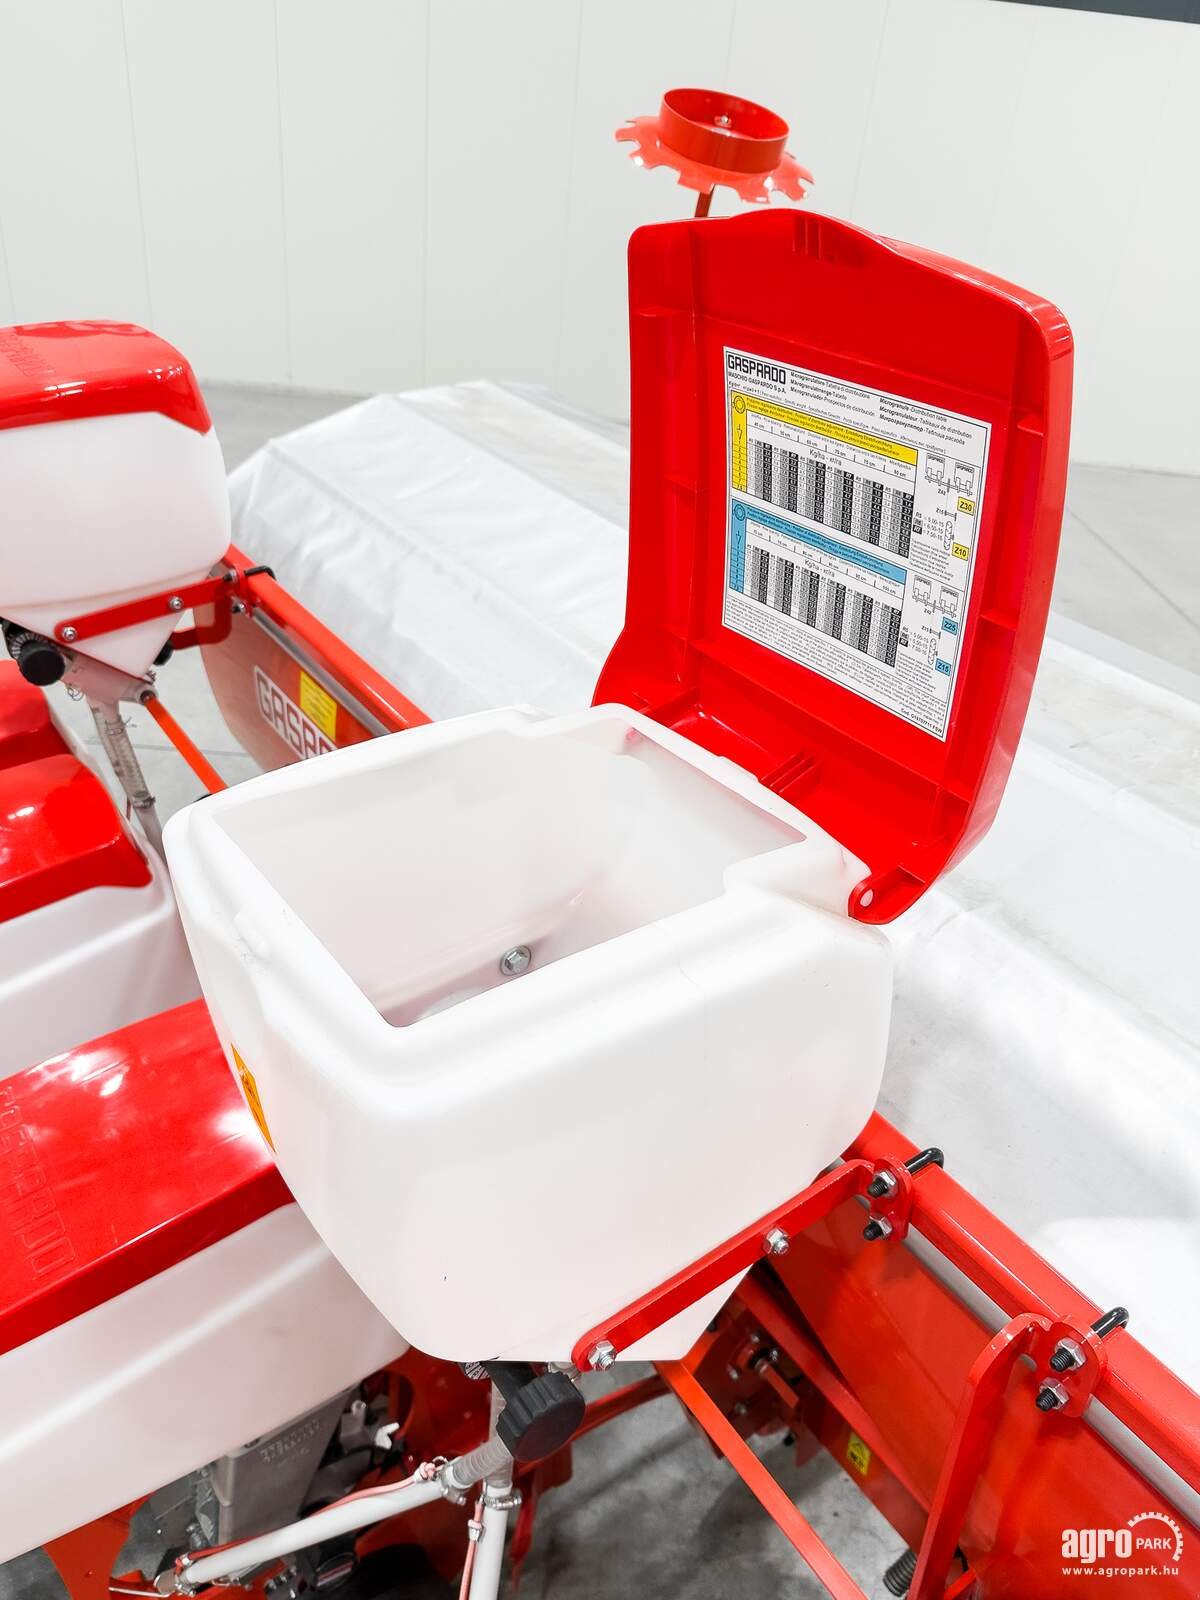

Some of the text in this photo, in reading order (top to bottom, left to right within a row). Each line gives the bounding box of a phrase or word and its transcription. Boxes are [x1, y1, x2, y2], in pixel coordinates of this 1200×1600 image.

[728, 353, 786, 385] GASPARDO
[748, 377, 773, 389] GASPARDO
[959, 500, 972, 512] Z30
[954, 546, 966, 557] Z10
[944, 620, 956, 632] Z25
[937, 661, 949, 673] Z15
